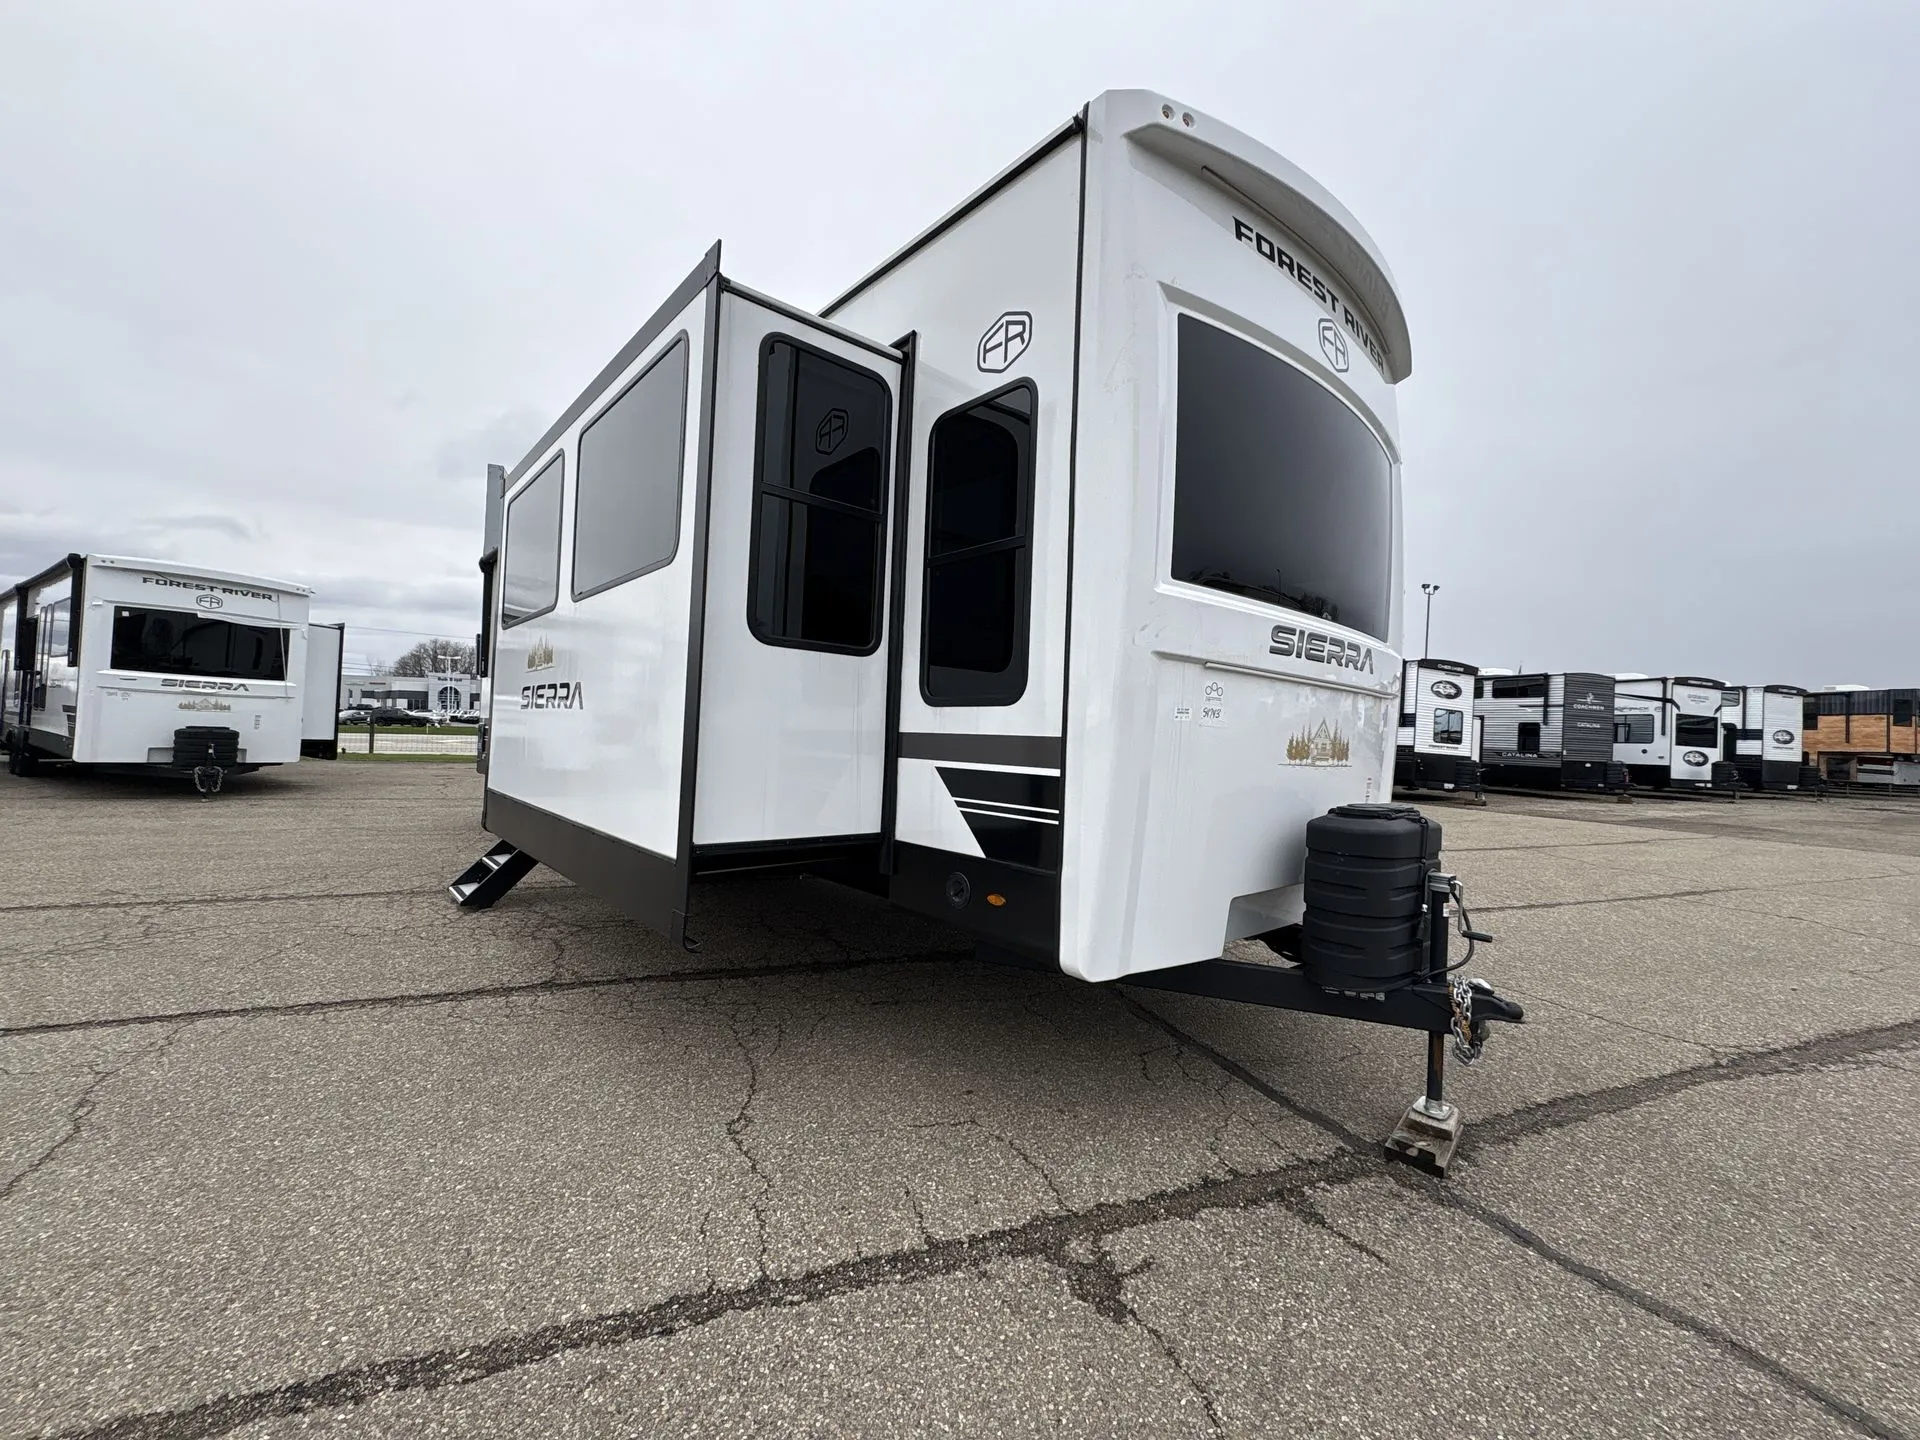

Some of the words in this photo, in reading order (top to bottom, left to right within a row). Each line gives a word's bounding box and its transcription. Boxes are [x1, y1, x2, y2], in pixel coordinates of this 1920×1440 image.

[1232, 215, 1339, 314] FOREST
[1343, 303, 1385, 375] RIVER
[142, 576, 219, 592] FOREST
[221, 586, 274, 601] RIVER
[1269, 624, 1374, 675] SIERRA
[160, 678, 250, 692] SIERRA
[520, 681, 584, 710] SIERRA
[1501, 751, 1538, 759] CATALINA
